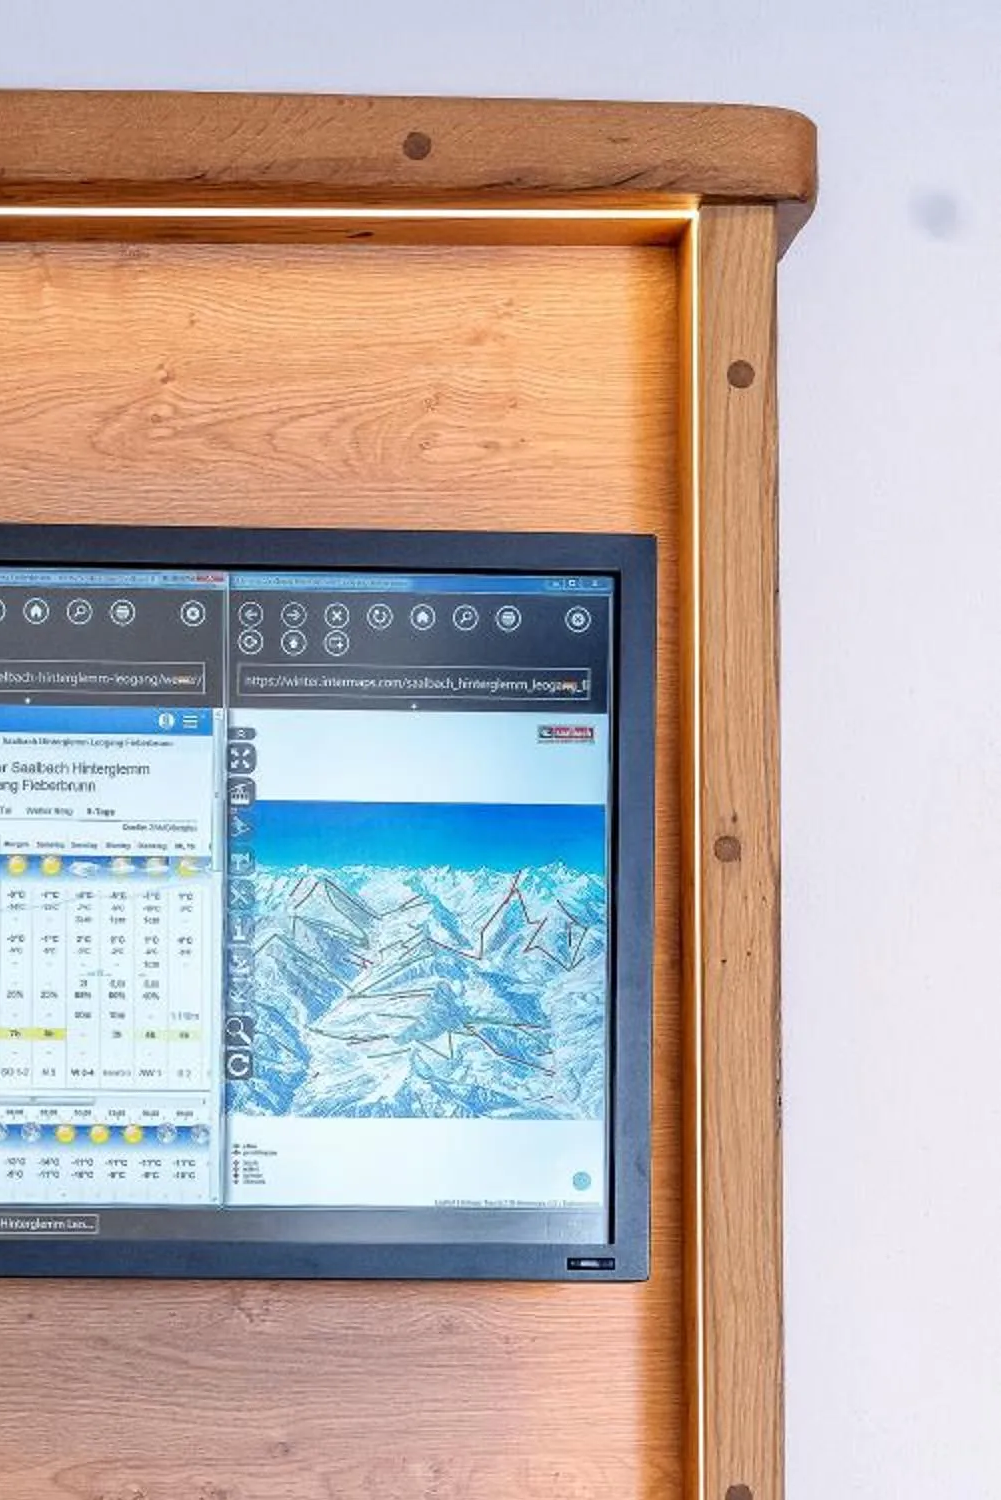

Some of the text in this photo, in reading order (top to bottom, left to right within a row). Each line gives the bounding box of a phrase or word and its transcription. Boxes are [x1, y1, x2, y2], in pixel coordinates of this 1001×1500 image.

[11, 761, 70, 774] Saalbach
[72, 762, 150, 777] Hinterglemm
[22, 780, 96, 792] Fieberbrunn
